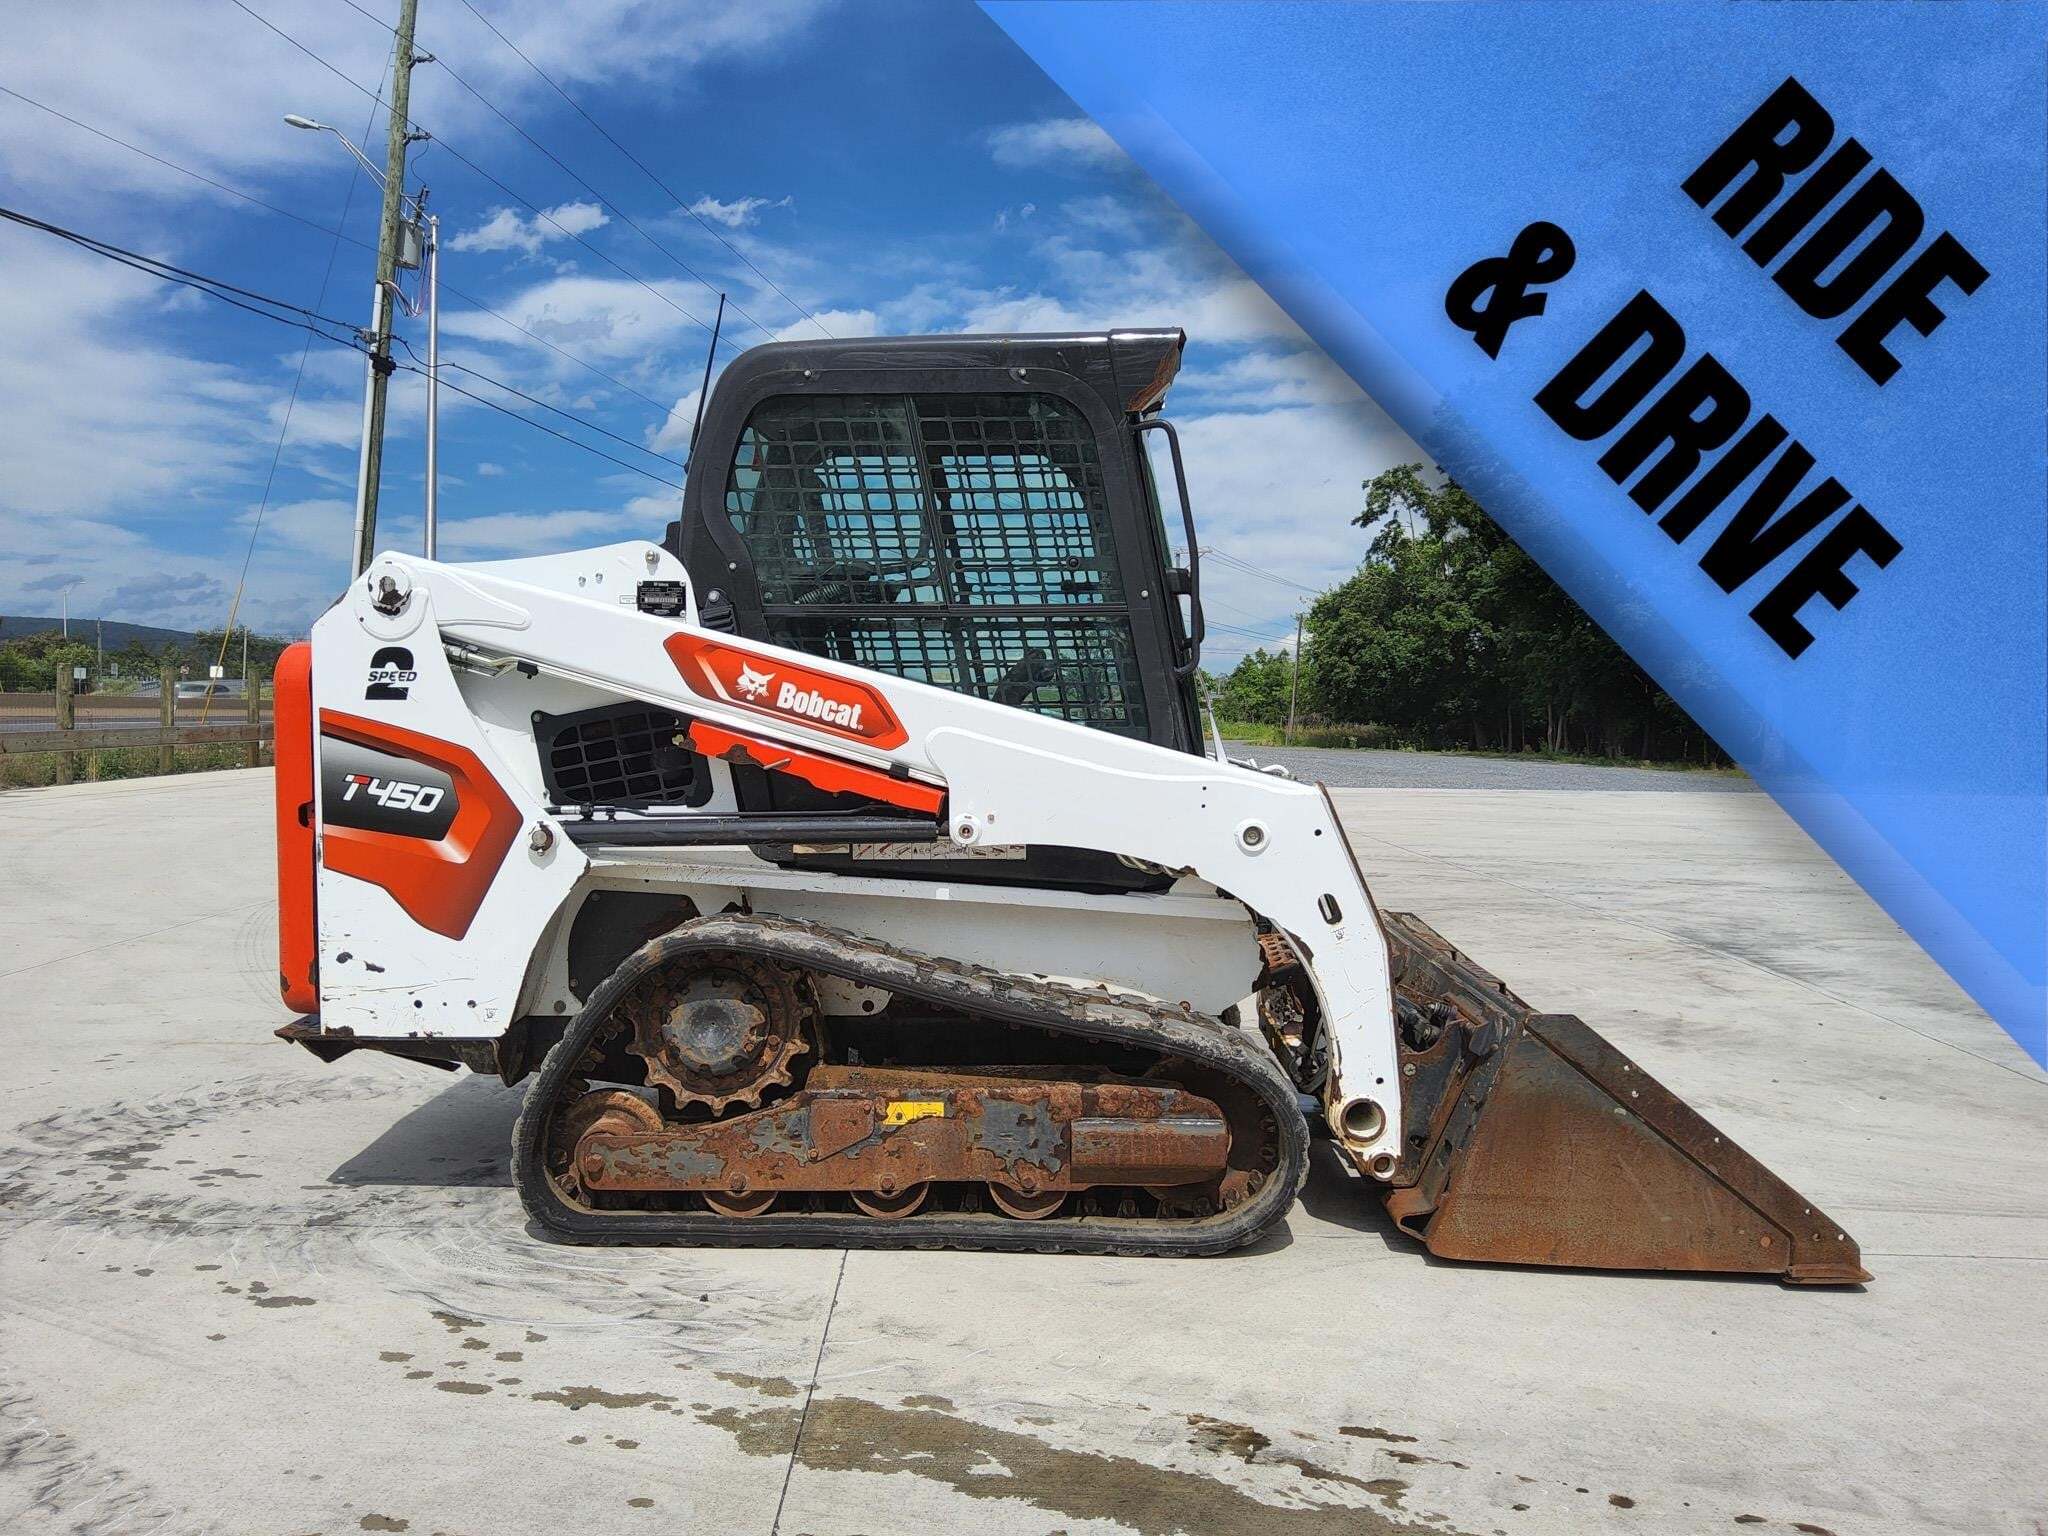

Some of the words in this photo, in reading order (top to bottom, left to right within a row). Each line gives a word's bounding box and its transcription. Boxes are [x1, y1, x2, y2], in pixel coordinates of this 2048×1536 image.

[365, 646, 414, 700] 2
[367, 670, 418, 682] SPEED
[776, 681, 862, 729] Bobcat
[342, 774, 445, 813] T450
